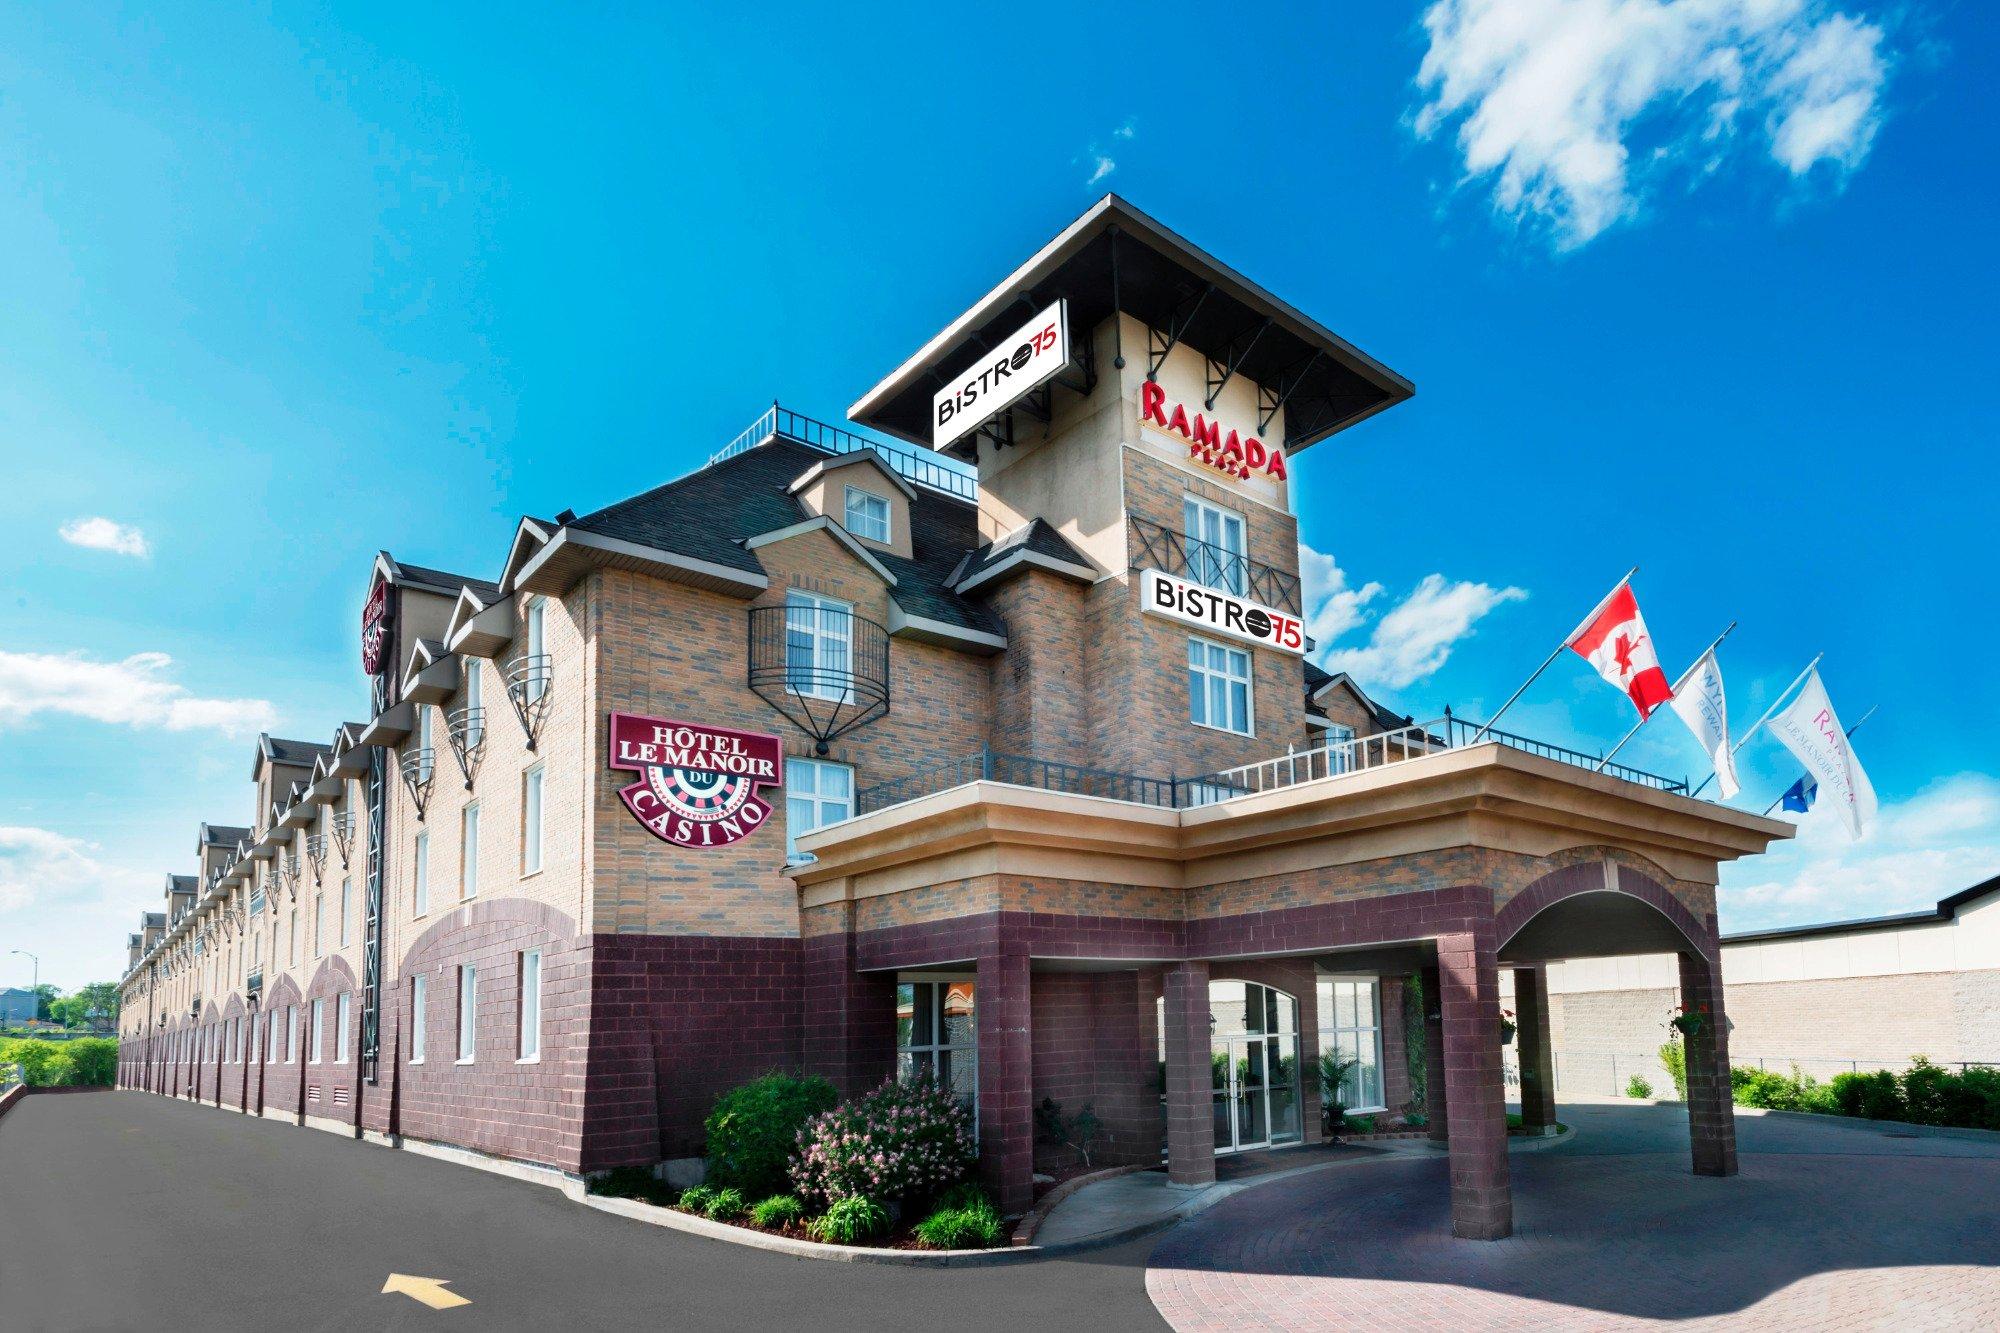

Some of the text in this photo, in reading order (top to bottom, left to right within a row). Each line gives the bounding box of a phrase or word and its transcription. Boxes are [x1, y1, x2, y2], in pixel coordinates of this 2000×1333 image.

[1142, 380, 1287, 481] RAMADA
[1190, 443, 1251, 480] PLAZA
[619, 740, 775, 777] LE MANOIR
[652, 726, 748, 756] HÔTEL
[689, 771, 714, 785] DU
[632, 789, 763, 845] CASINO
